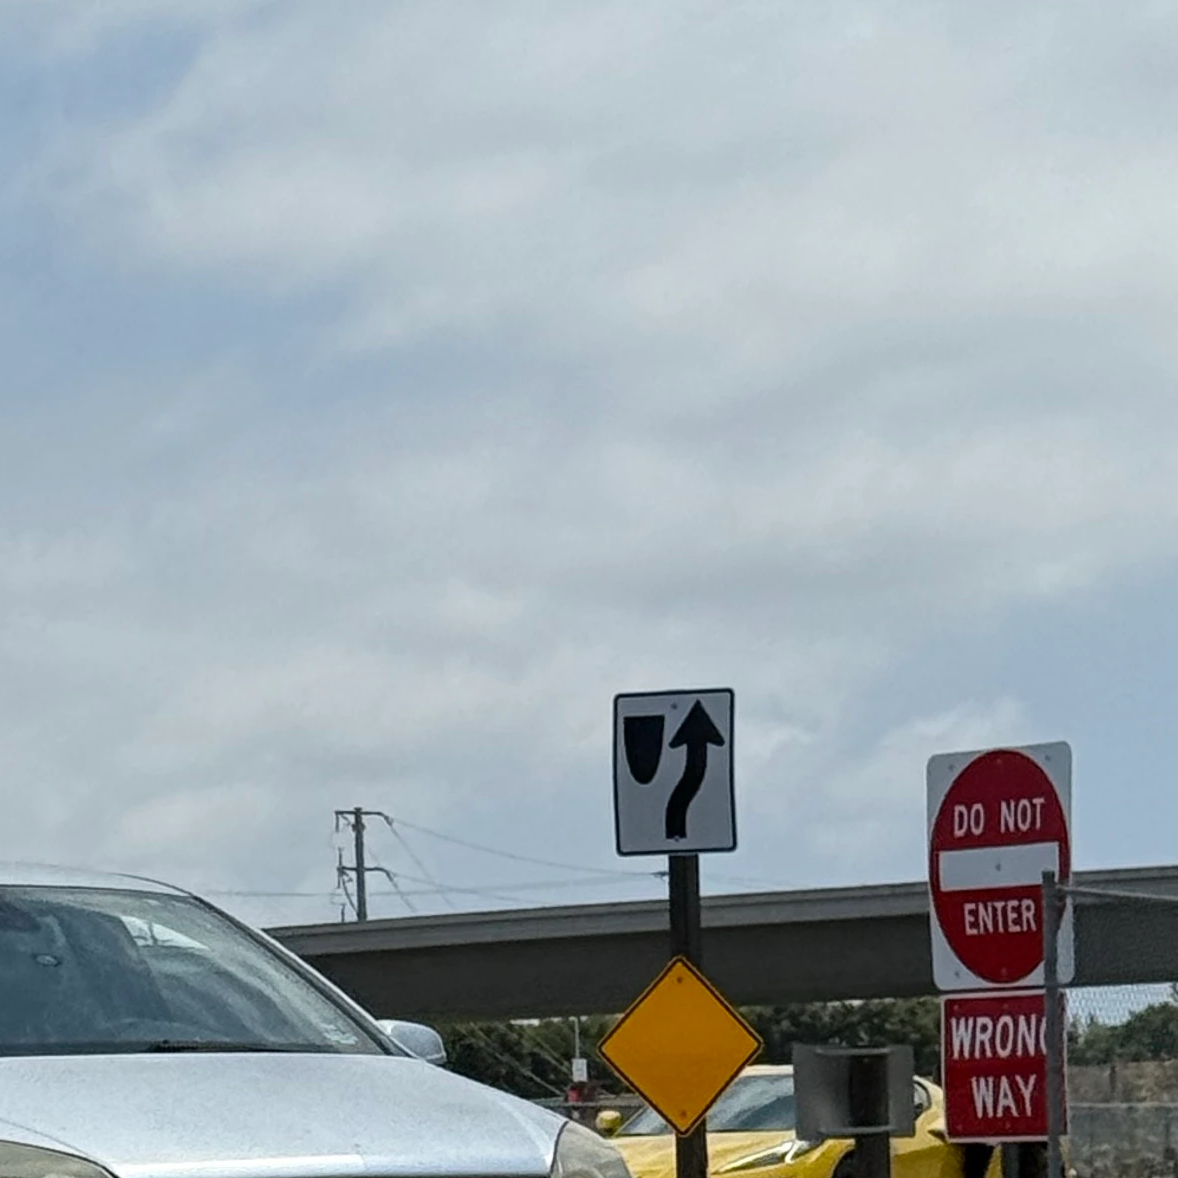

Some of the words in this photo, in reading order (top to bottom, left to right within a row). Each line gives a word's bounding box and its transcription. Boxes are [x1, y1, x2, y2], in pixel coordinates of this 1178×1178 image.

[954, 803, 985, 838] DO
[1000, 797, 1046, 834] NOT
[963, 899, 1038, 936] ENTER
[970, 1073, 1038, 1120] WAY
